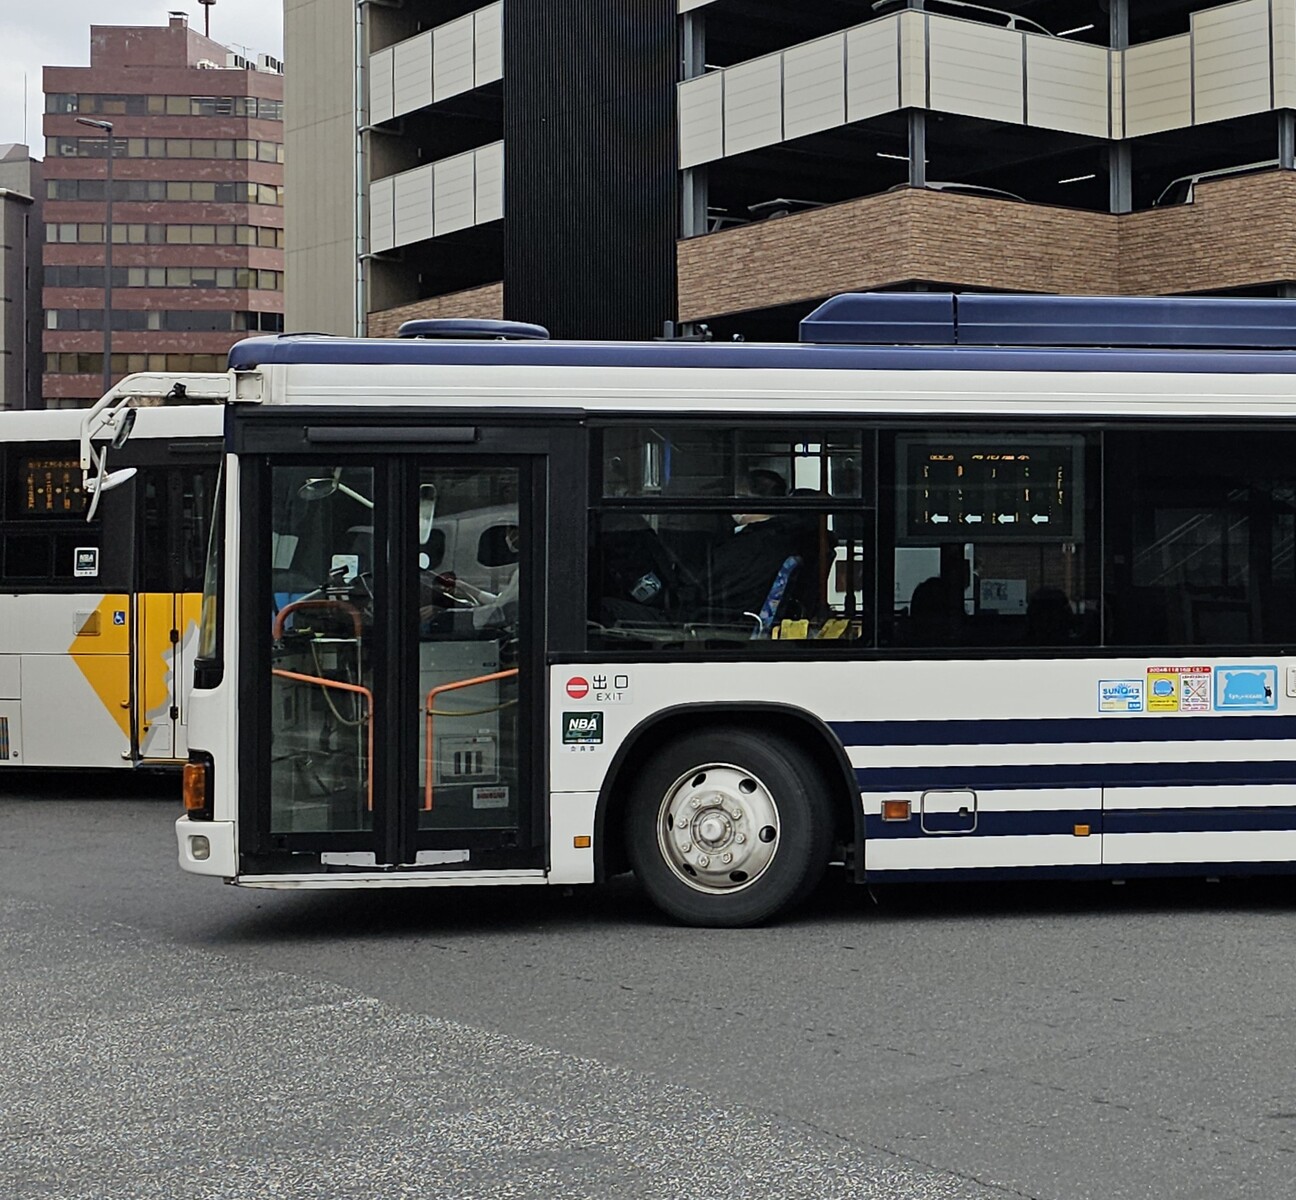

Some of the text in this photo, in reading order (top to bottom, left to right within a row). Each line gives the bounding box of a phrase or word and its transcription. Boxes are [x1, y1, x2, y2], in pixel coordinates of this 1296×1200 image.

[592, 674, 628, 689] 出口
[596, 692, 623, 702] EXIT
[569, 718, 597, 731] NBA
